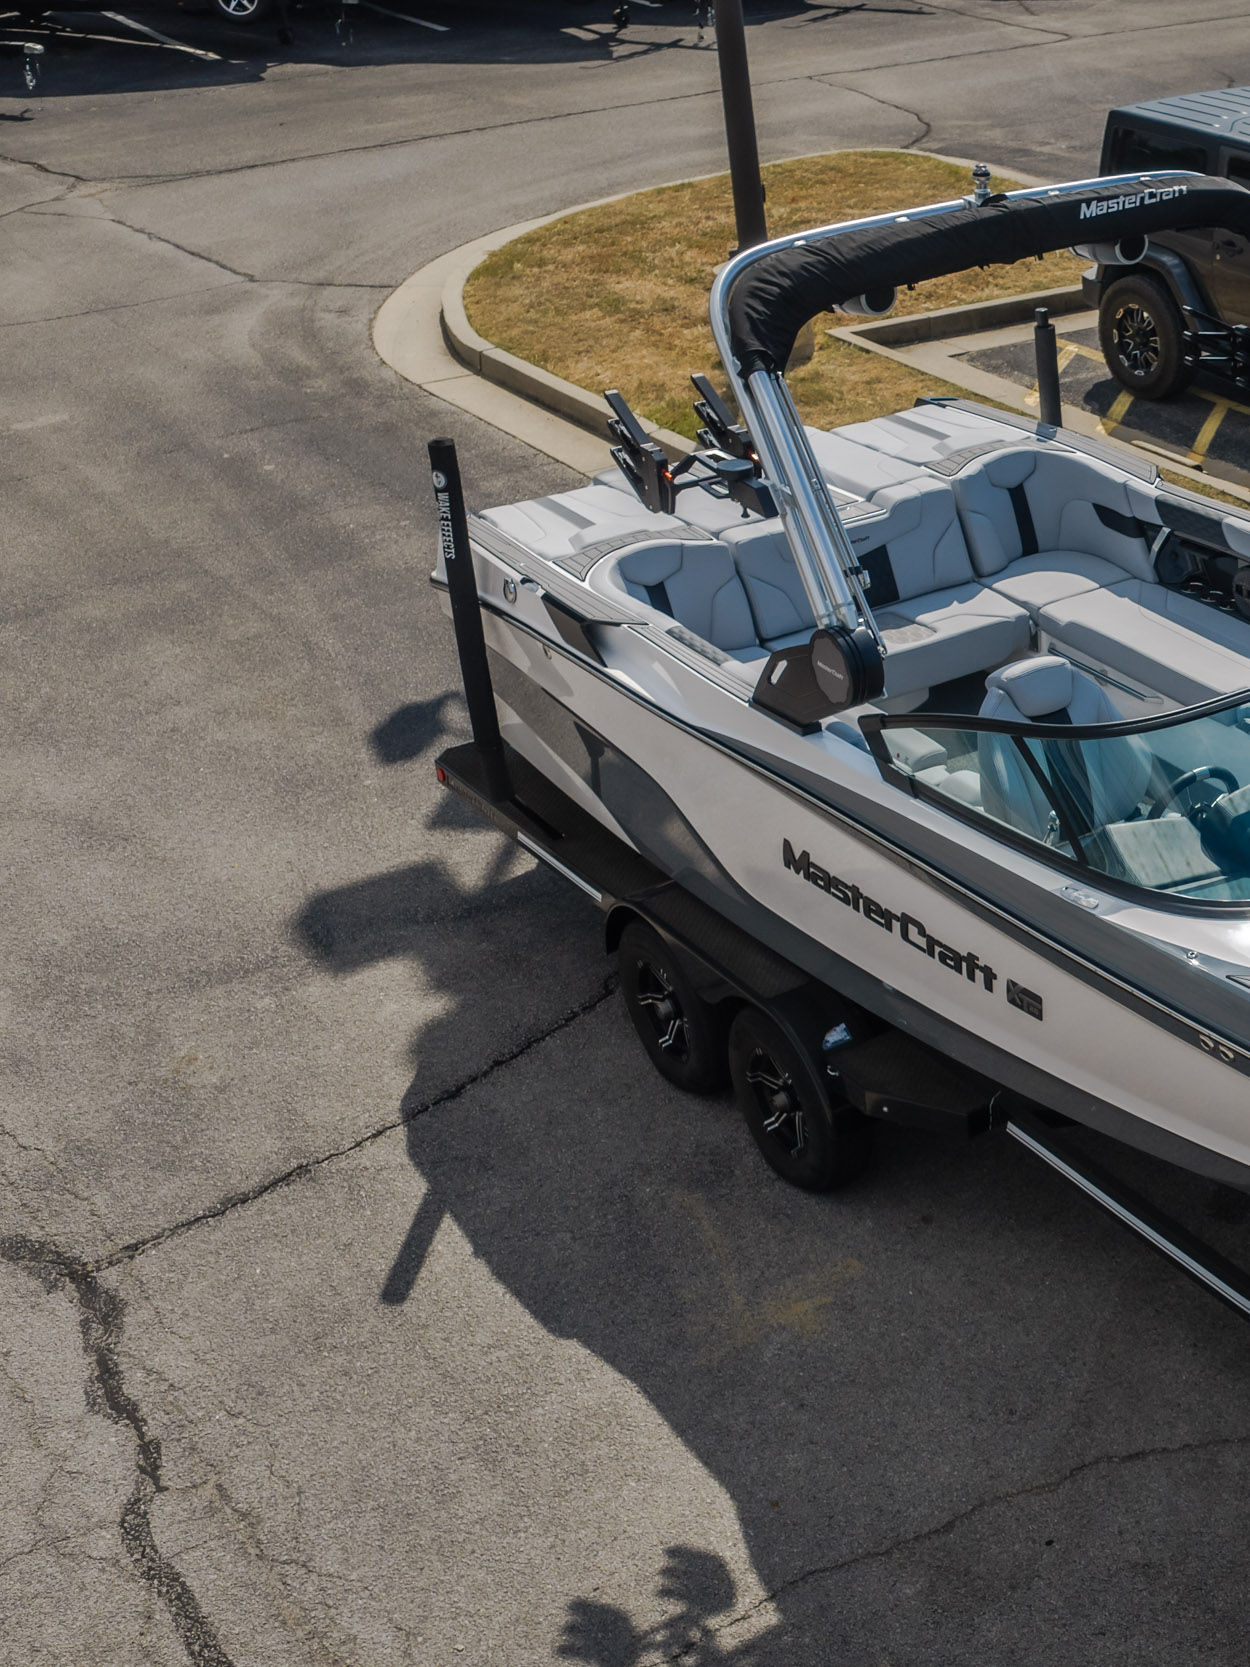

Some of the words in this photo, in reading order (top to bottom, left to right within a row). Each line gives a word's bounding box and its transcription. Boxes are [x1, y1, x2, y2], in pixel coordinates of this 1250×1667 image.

[1079, 185, 1188, 220] MasterCraft
[437, 493, 451, 520] WAKE
[441, 520, 456, 560] EFFECTS
[783, 838, 997, 994] MasterCraft
